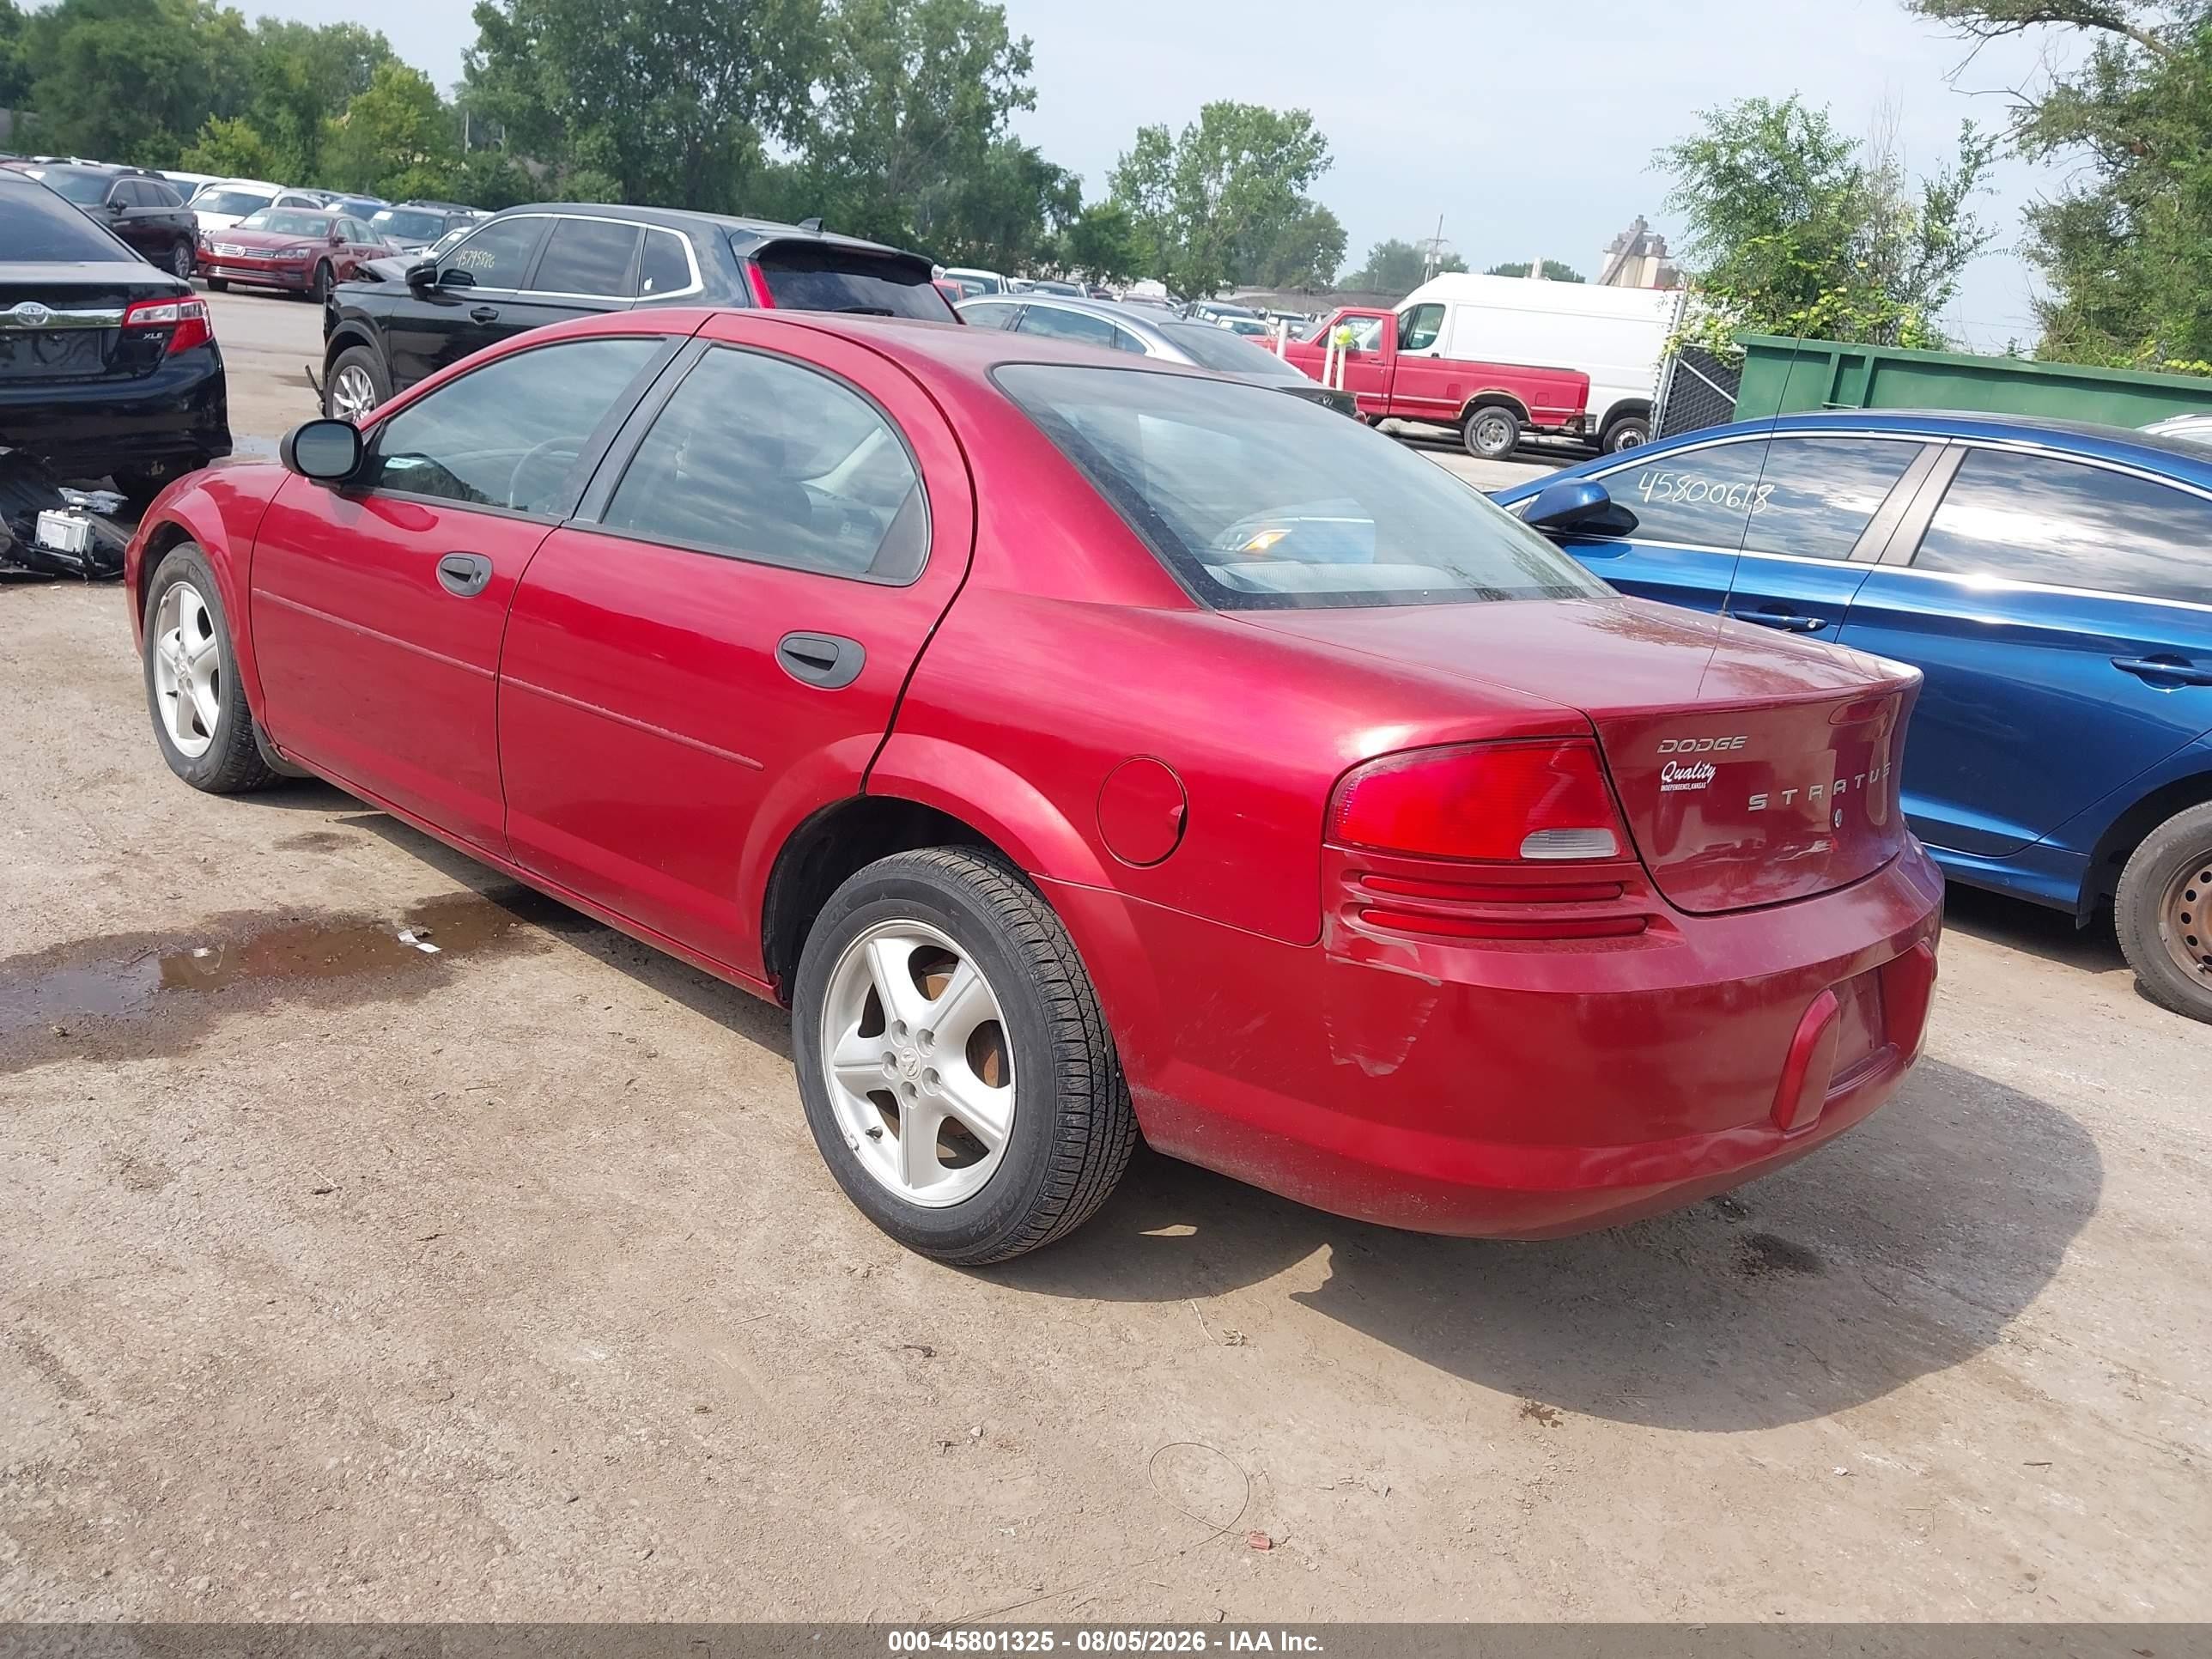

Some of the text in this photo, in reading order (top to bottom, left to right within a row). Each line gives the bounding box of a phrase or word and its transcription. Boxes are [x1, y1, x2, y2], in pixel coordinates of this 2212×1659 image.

[143, 331, 164, 340] XLE
[1638, 471, 1776, 514] 45800618
[1656, 735, 1749, 754] DODGE
[1661, 759, 1717, 784] Quality
[1747, 762, 1892, 811] STRATUS
